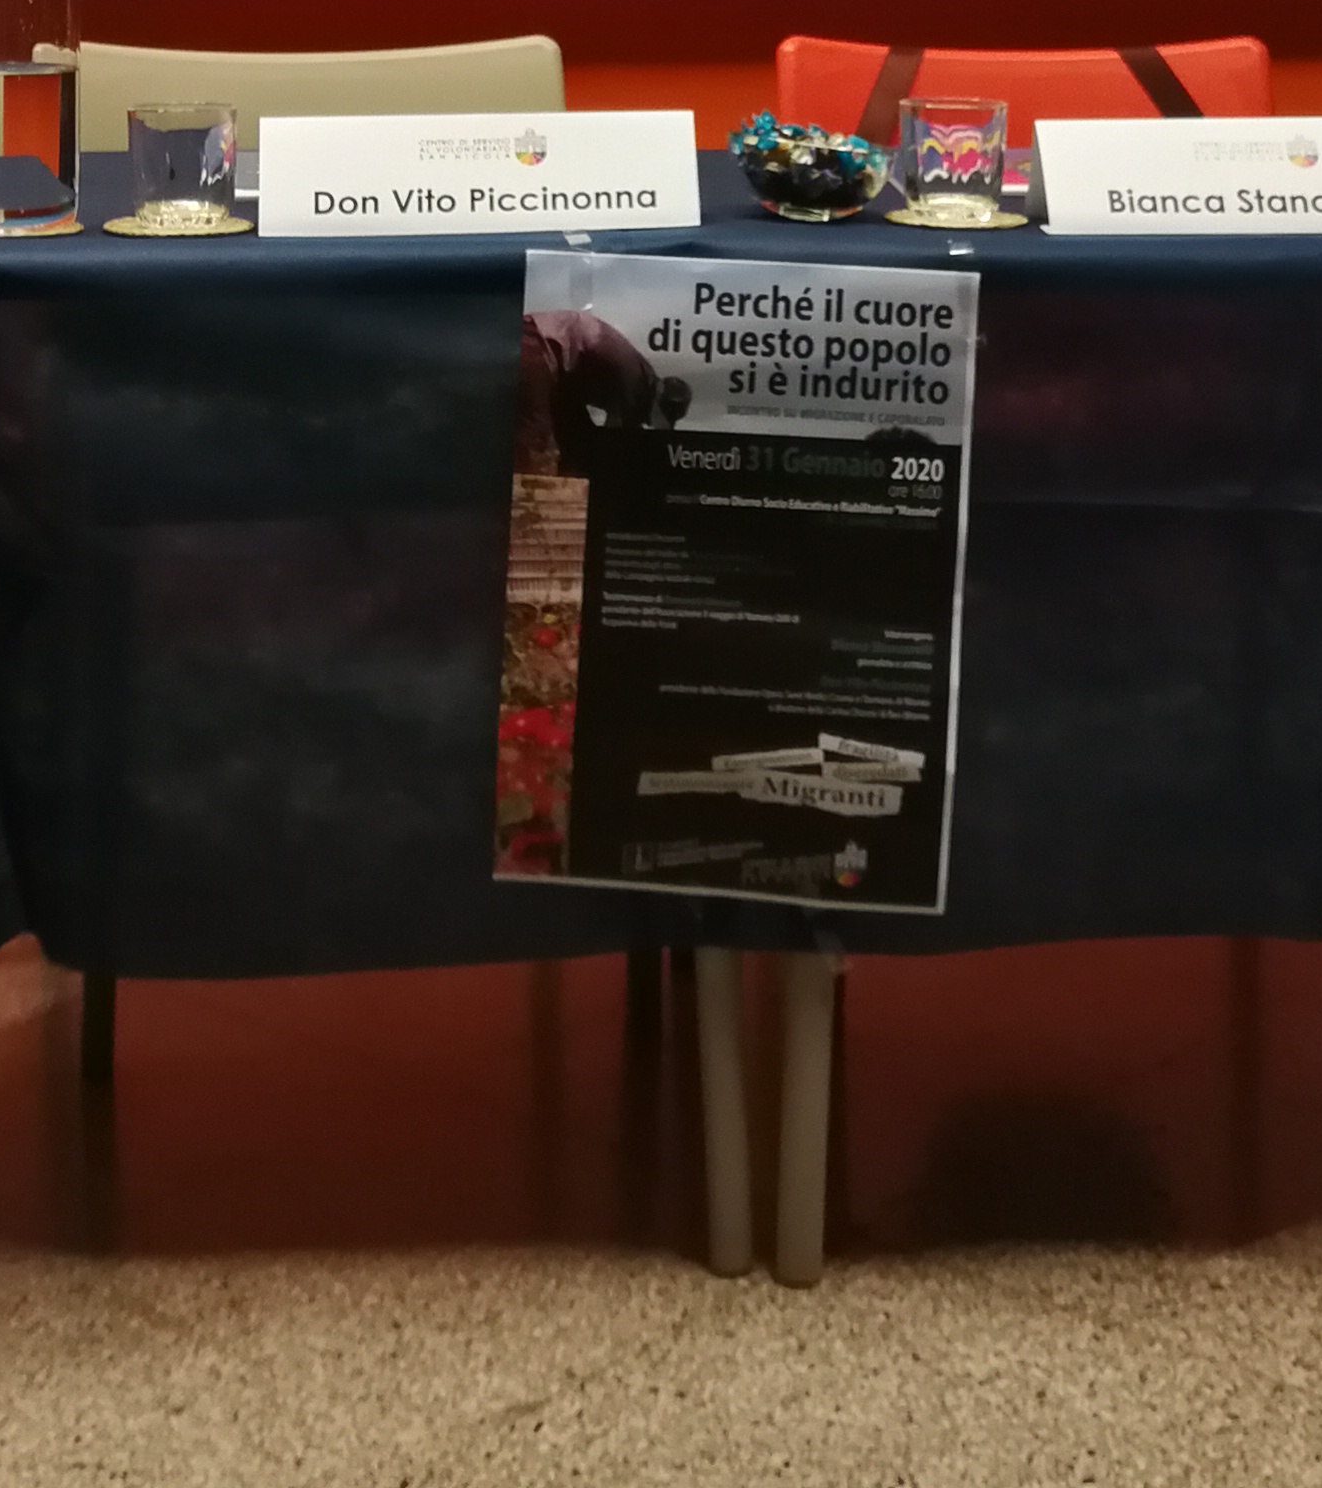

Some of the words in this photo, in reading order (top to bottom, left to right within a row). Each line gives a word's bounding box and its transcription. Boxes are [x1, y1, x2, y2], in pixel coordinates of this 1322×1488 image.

[314, 190, 380, 215] Don
[391, 188, 457, 214] Vito
[469, 186, 658, 213] Piccinonna
[1108, 189, 1226, 214] Bianca
[693, 282, 815, 321] Perché
[824, 288, 845, 323] il
[853, 298, 954, 330] cuore
[647, 318, 682, 353] di
[690, 327, 815, 363] questo
[824, 332, 952, 372] popolo
[728, 362, 757, 394] si
[768, 363, 788, 395] è
[799, 364, 950, 405] indurito
[745, 445, 775, 472] 31
[781, 446, 886, 478] Gennaio
[890, 456, 945, 483] 2020
[763, 776, 886, 808] Migranti
